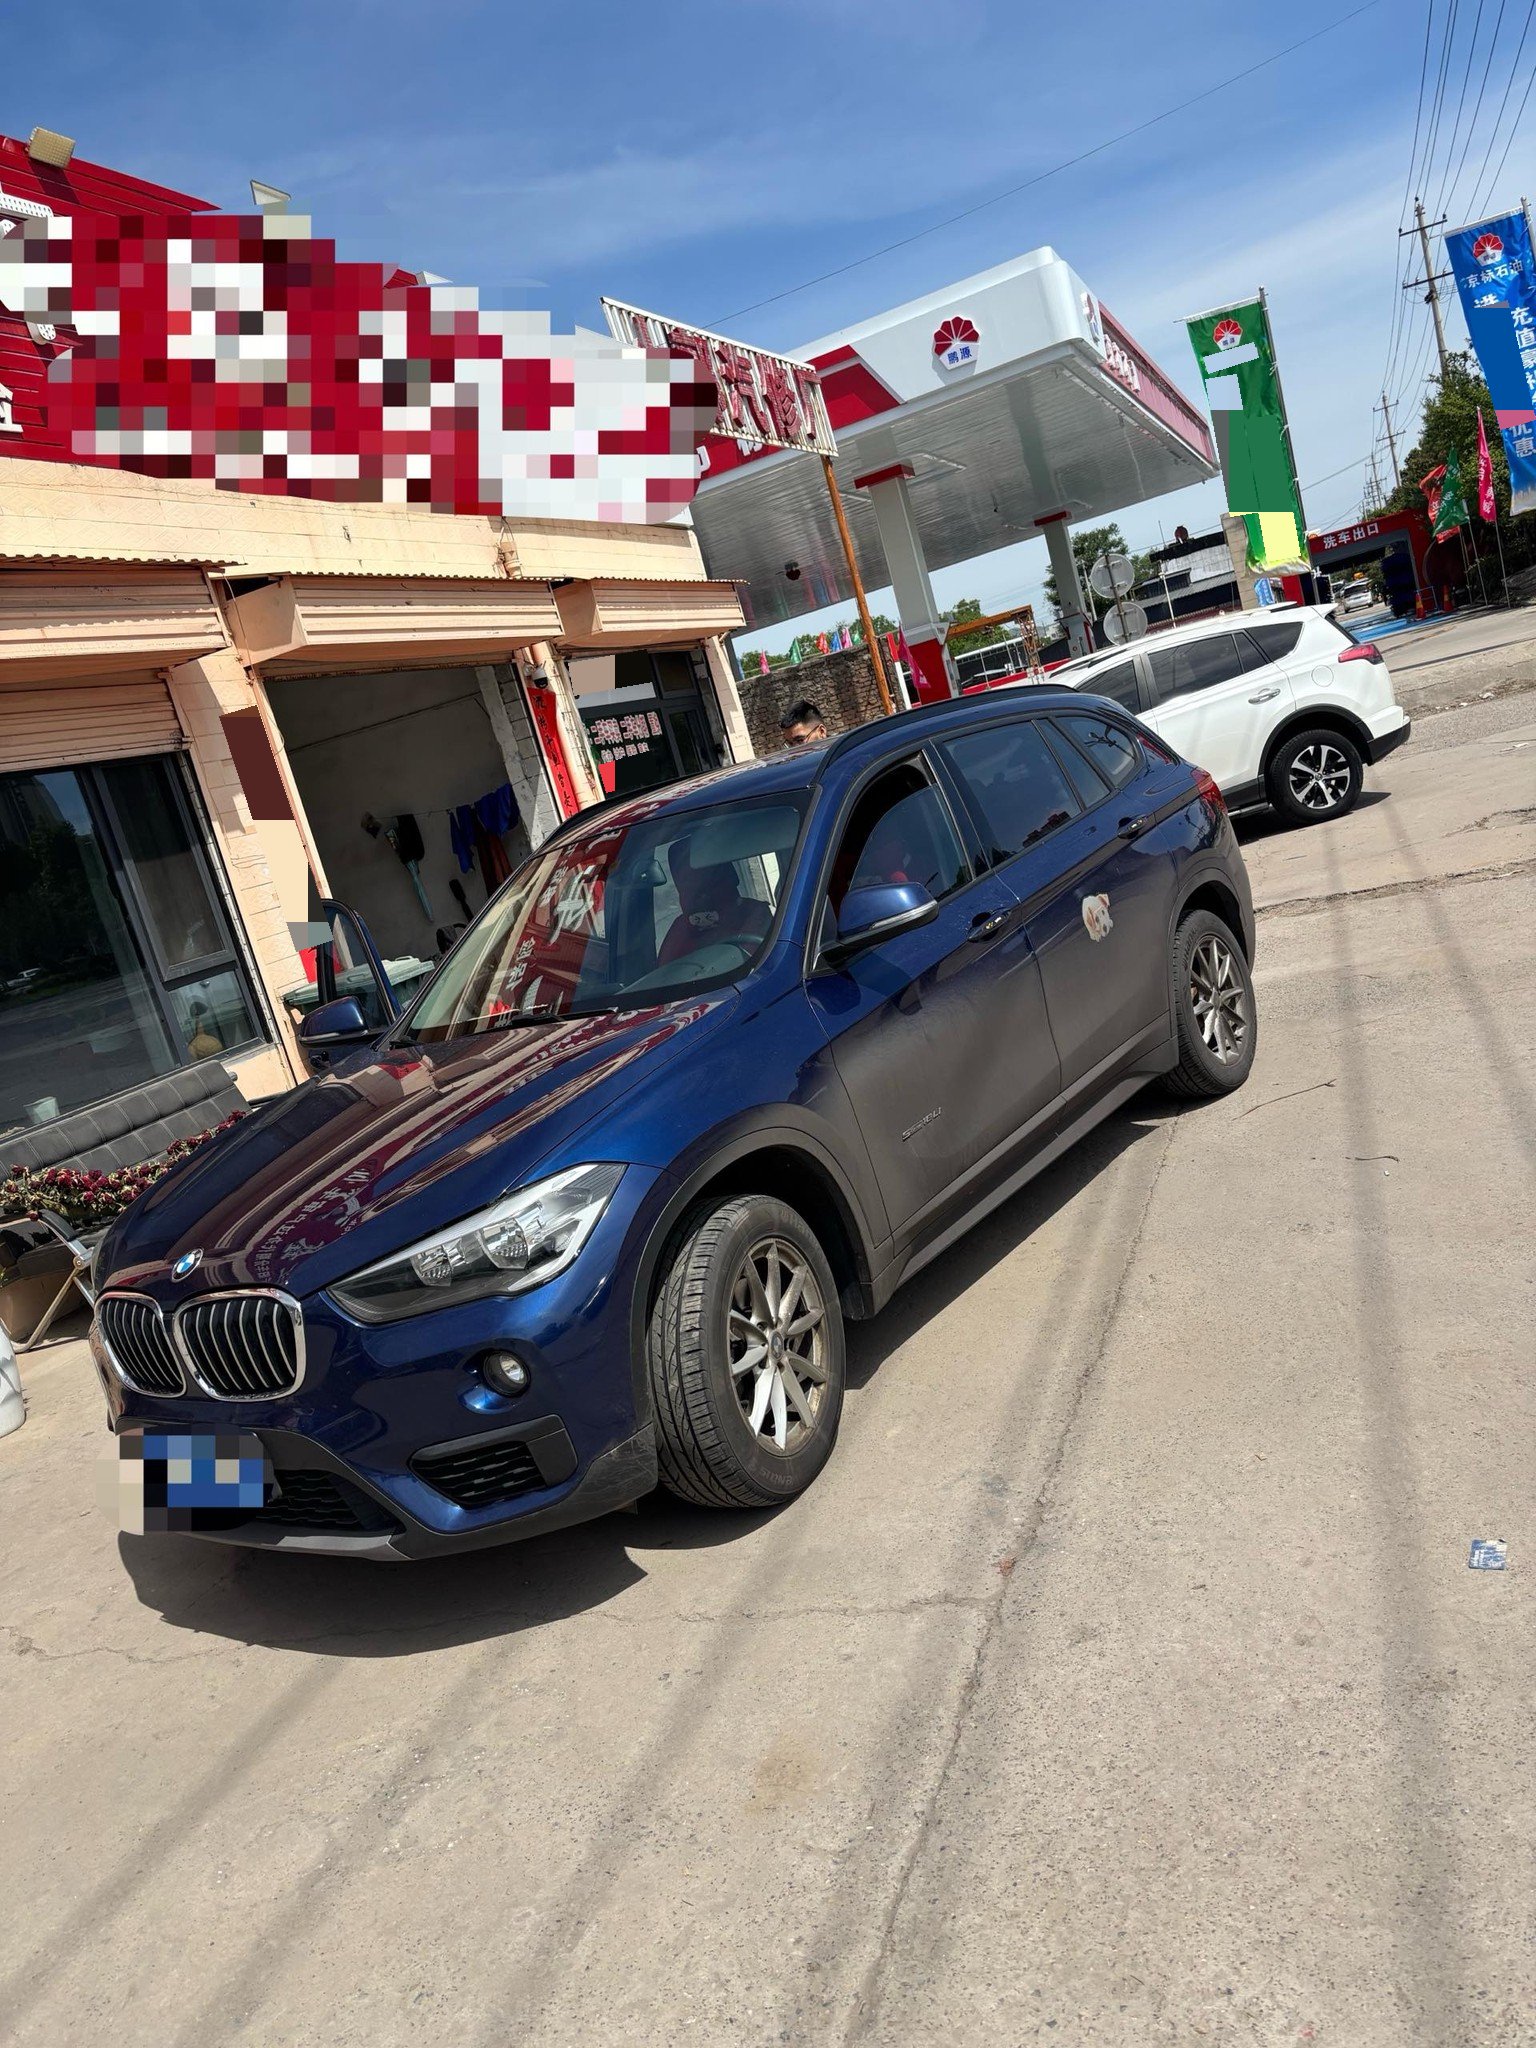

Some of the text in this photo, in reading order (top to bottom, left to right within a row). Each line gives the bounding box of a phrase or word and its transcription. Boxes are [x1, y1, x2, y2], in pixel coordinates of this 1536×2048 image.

[1465, 259, 1523, 288] 京标石油
[1323, 523, 1379, 549] 洗车出口
